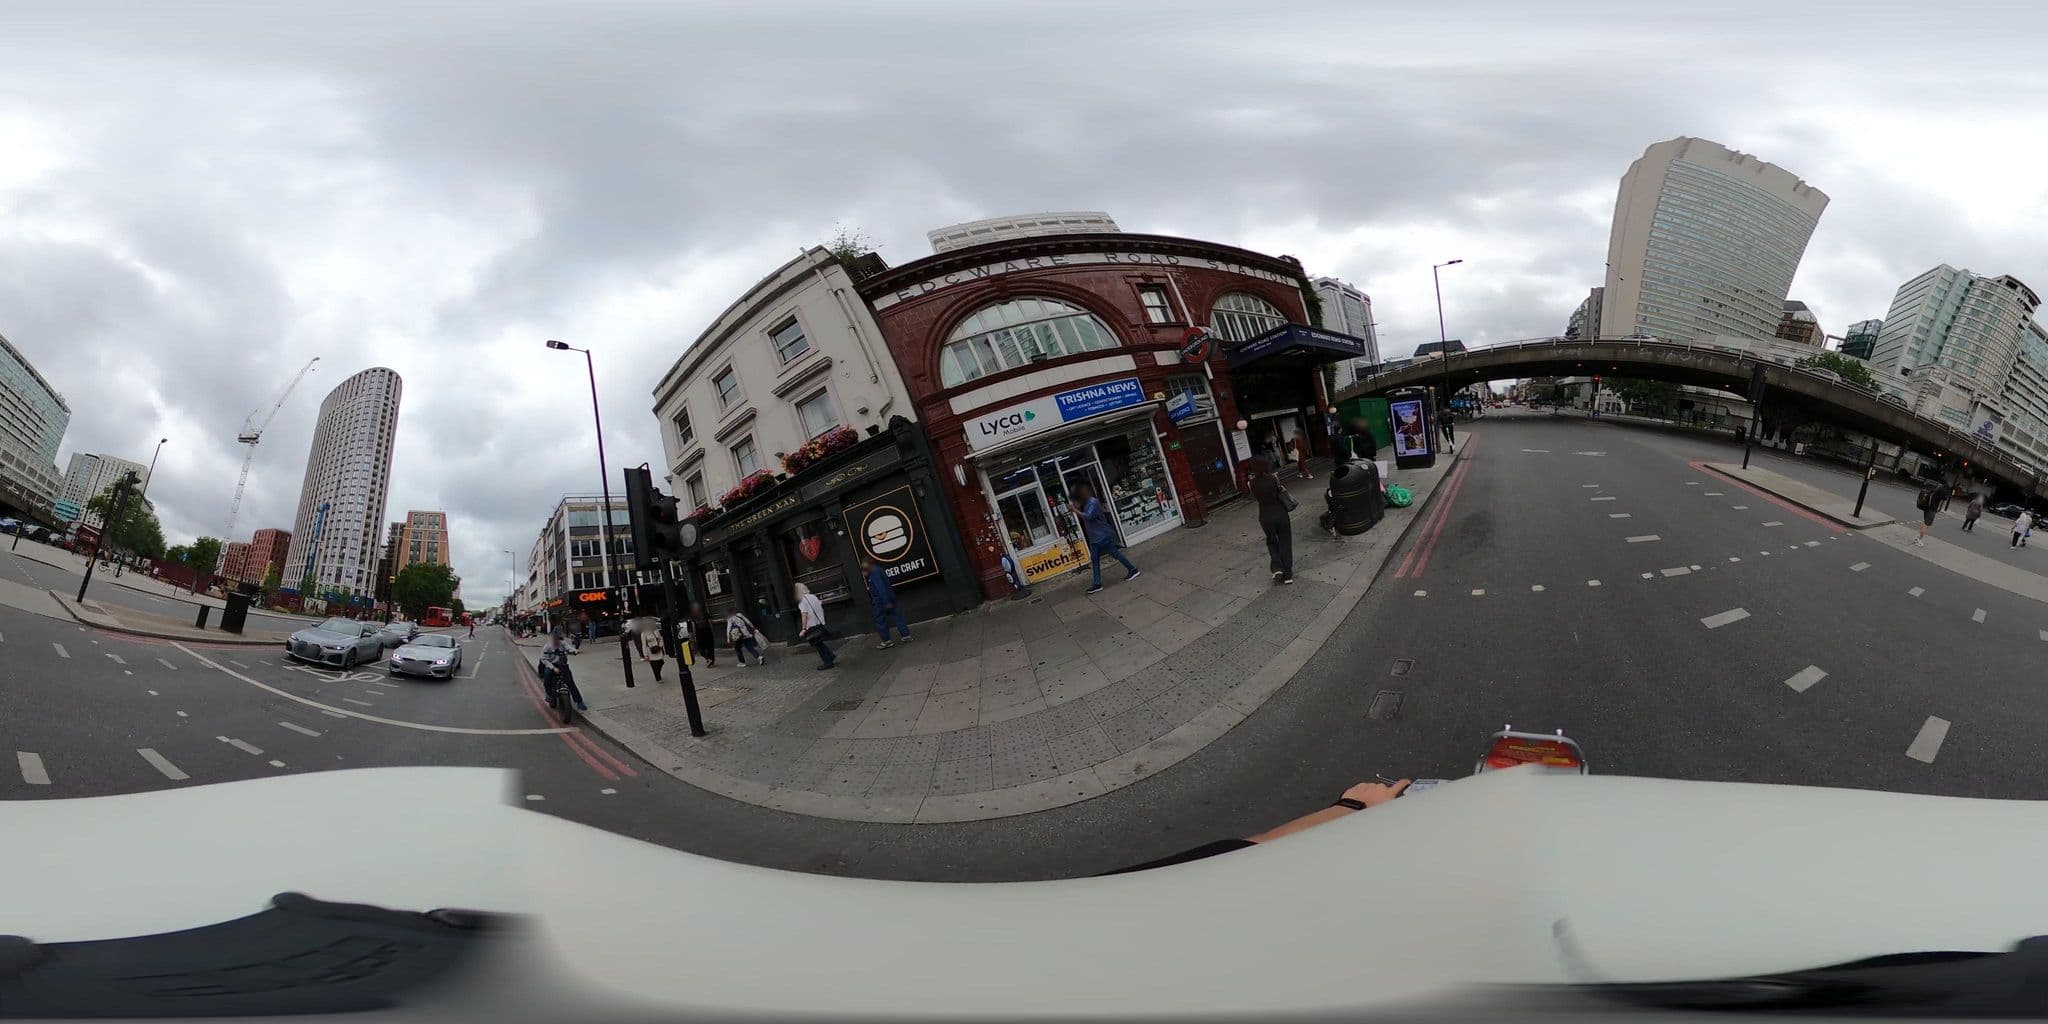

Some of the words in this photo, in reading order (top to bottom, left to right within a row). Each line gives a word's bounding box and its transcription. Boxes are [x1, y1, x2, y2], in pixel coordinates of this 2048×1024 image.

[1104, 252, 1180, 265] ROAD
[1207, 259, 1290, 285] STATION
[1059, 388, 1107, 405] TRISHNA
[1107, 381, 1137, 394] NEWS
[979, 412, 1024, 436] Lyca
[1002, 425, 1026, 437] Mobile
[731, 521, 745, 530] THE
[747, 508, 773, 524] GREEN
[775, 496, 796, 511] MAN
[885, 566, 900, 577] GER
[900, 558, 926, 573] CRAFT
[1026, 554, 1070, 577] switch
[579, 591, 607, 602] GDK
